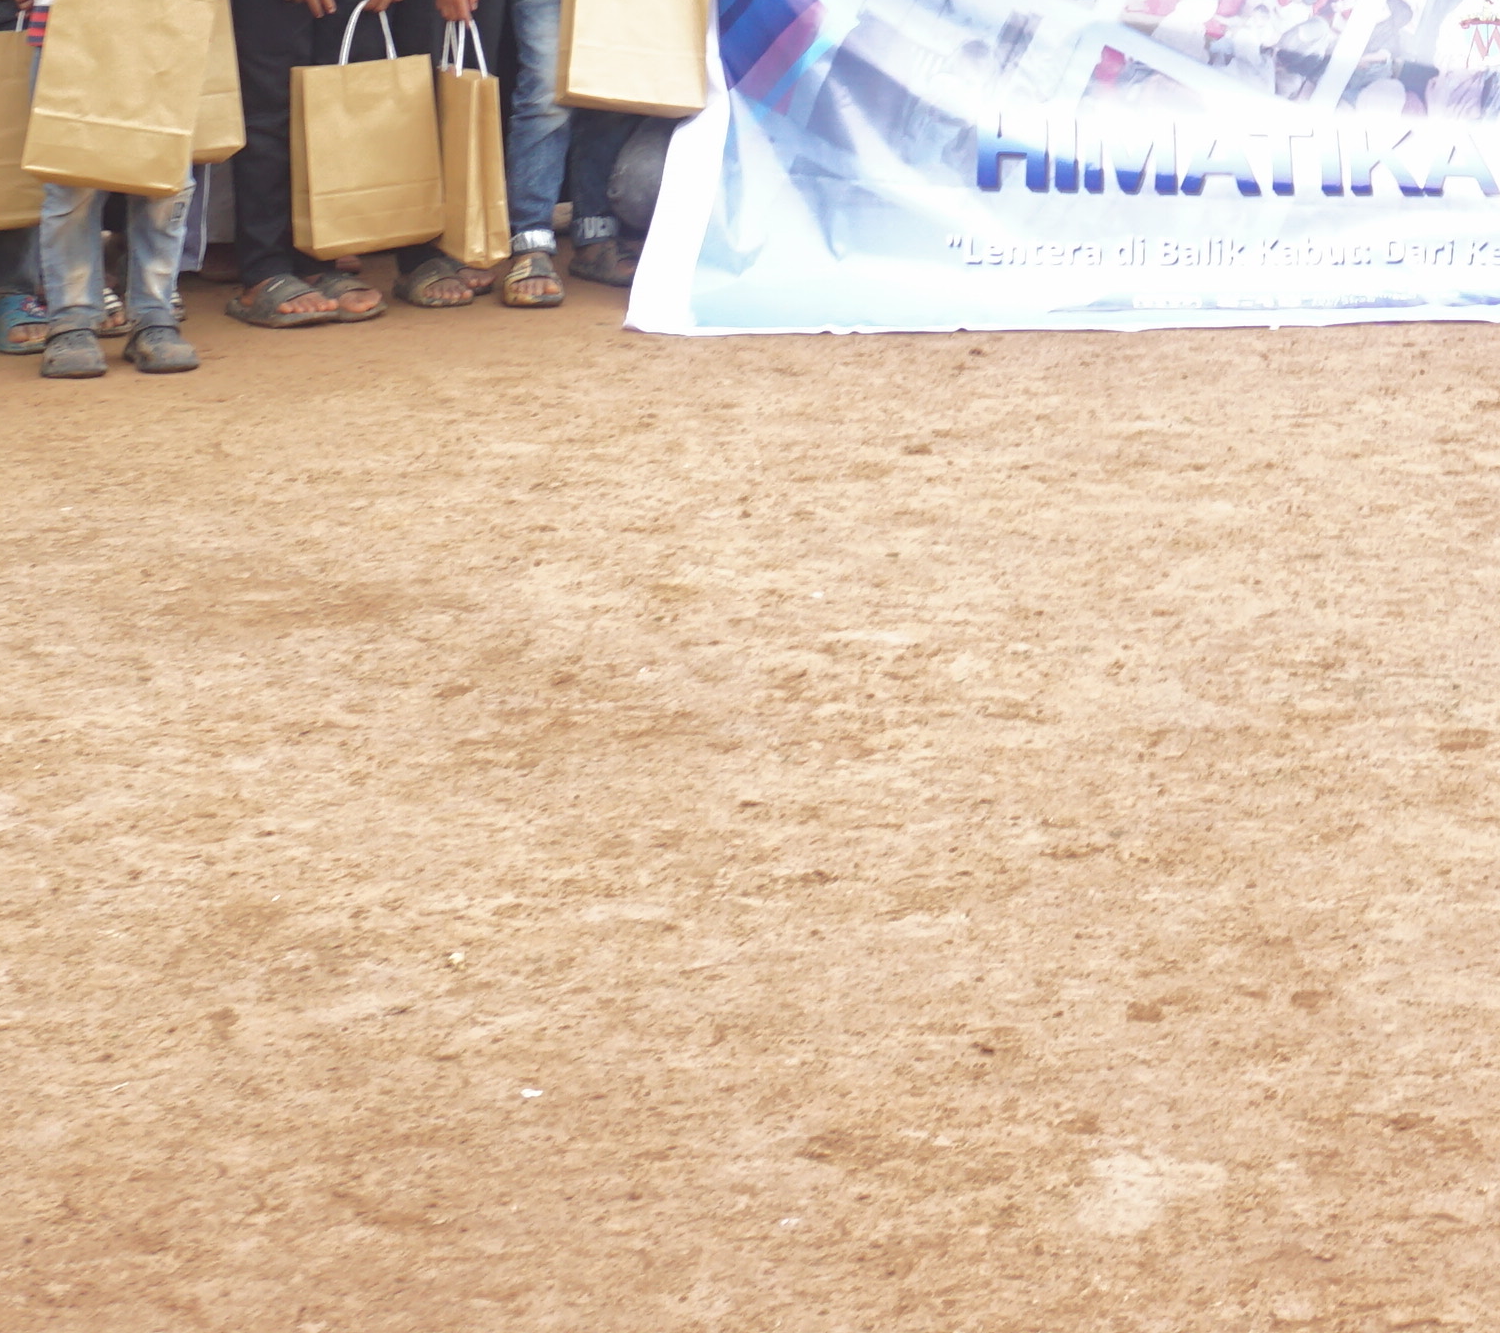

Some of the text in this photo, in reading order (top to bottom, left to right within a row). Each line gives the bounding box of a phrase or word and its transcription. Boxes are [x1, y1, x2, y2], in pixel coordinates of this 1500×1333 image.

[975, 112, 1500, 197] HIMATIKA
[1116, 236, 1146, 266] di
[1161, 237, 1243, 267] Balik
[1384, 239, 1454, 268] Dari
